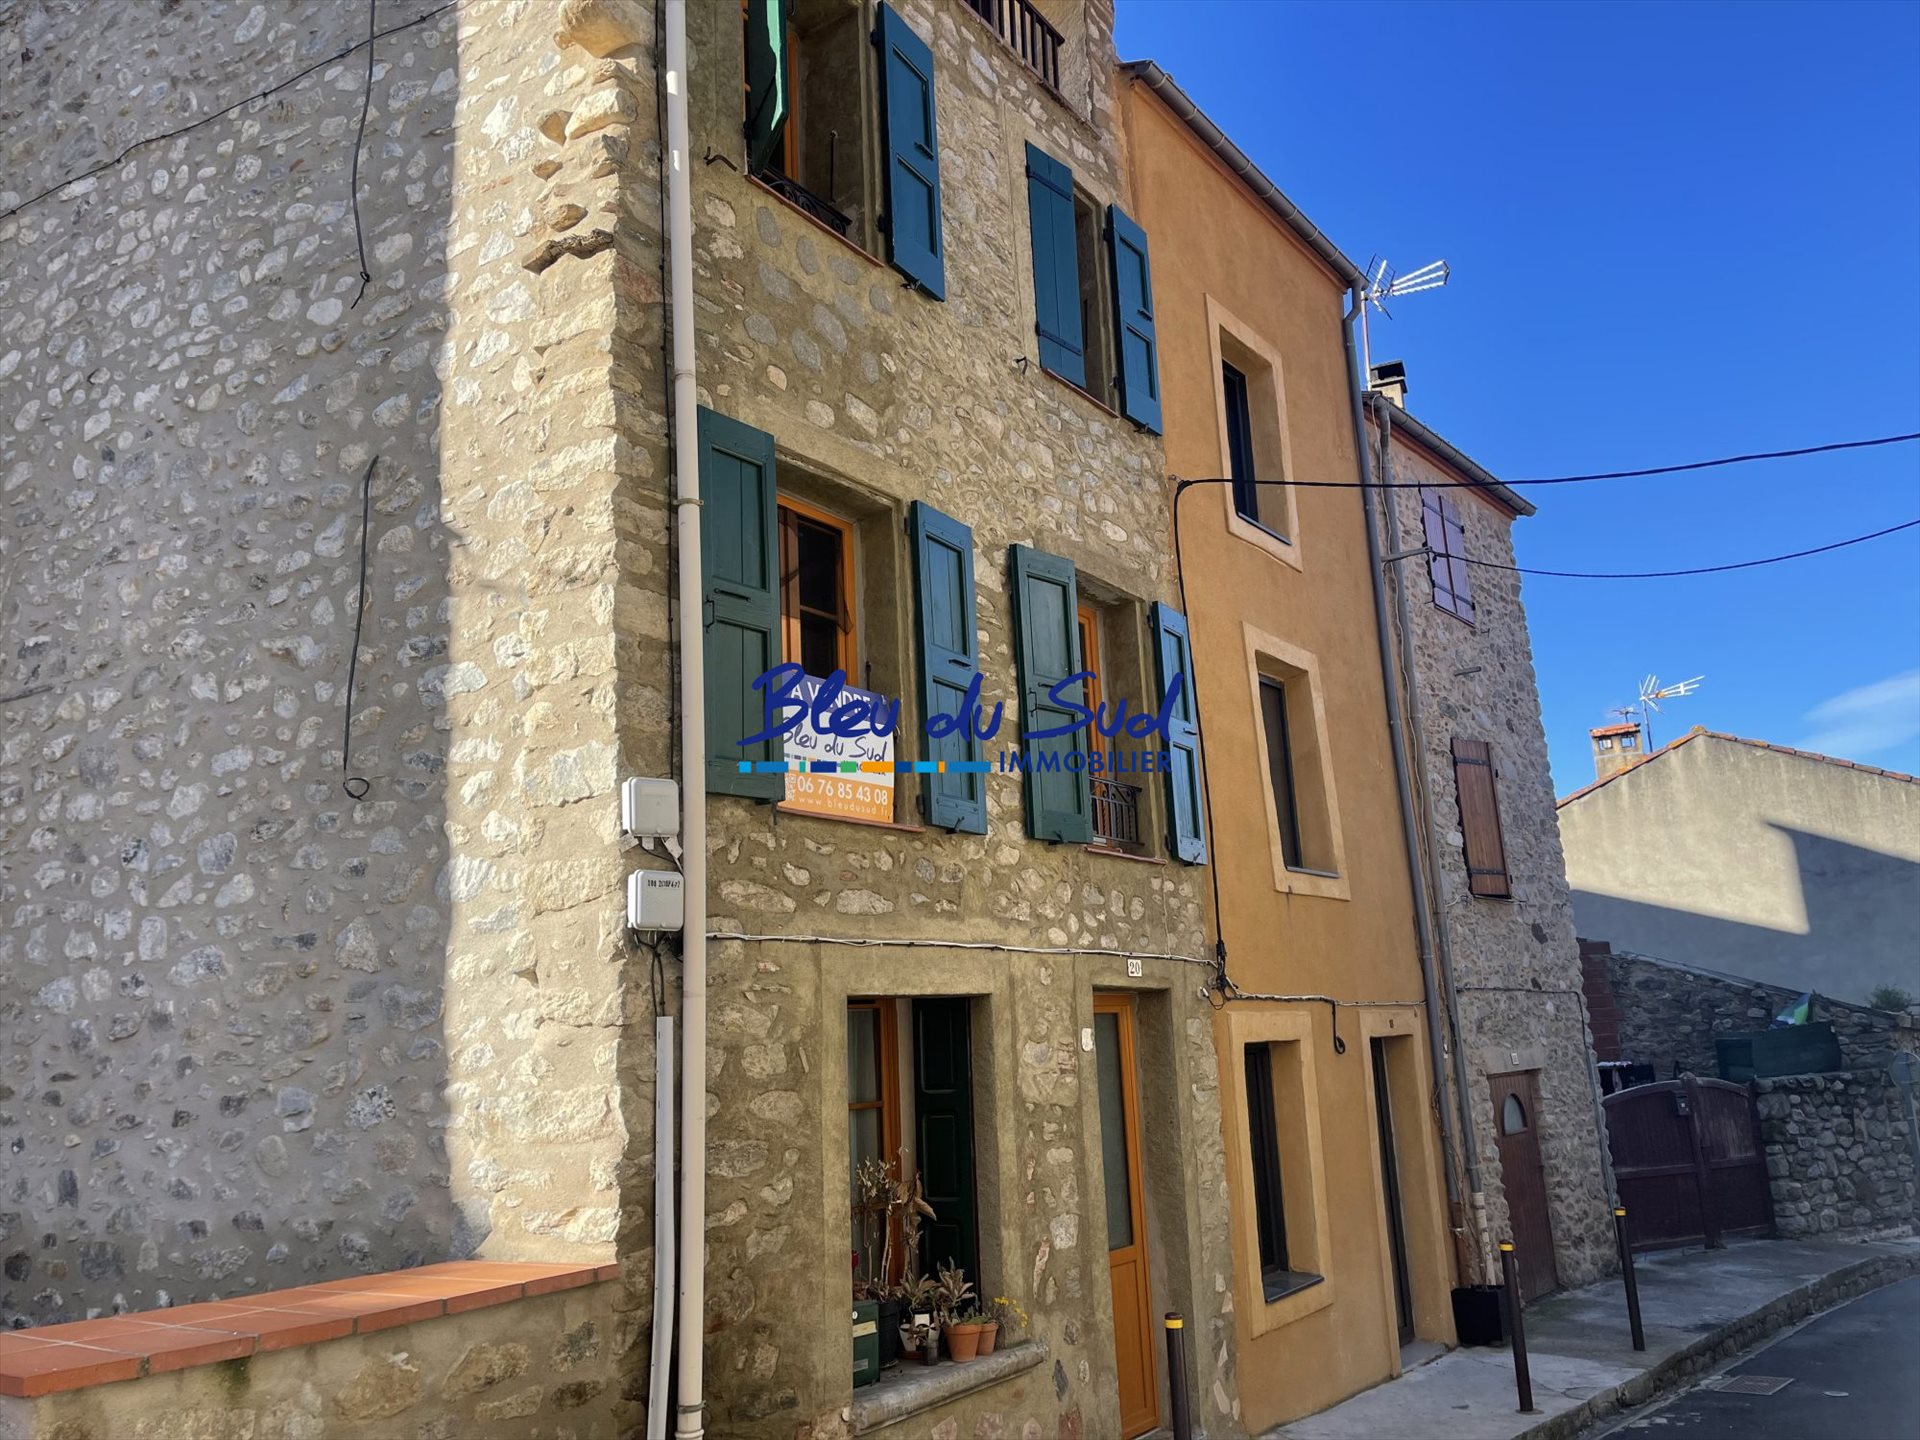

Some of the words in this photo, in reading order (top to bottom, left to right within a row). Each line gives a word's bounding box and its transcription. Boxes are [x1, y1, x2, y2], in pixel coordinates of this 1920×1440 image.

[824, 734, 844, 756] du
[849, 736, 887, 762] Sud
[797, 776, 814, 793] 06
[818, 779, 834, 797] 76
[838, 782, 853, 800] 85
[856, 785, 871, 803] 43
[874, 788, 888, 806] 08
[1129, 962, 1141, 975] 20
